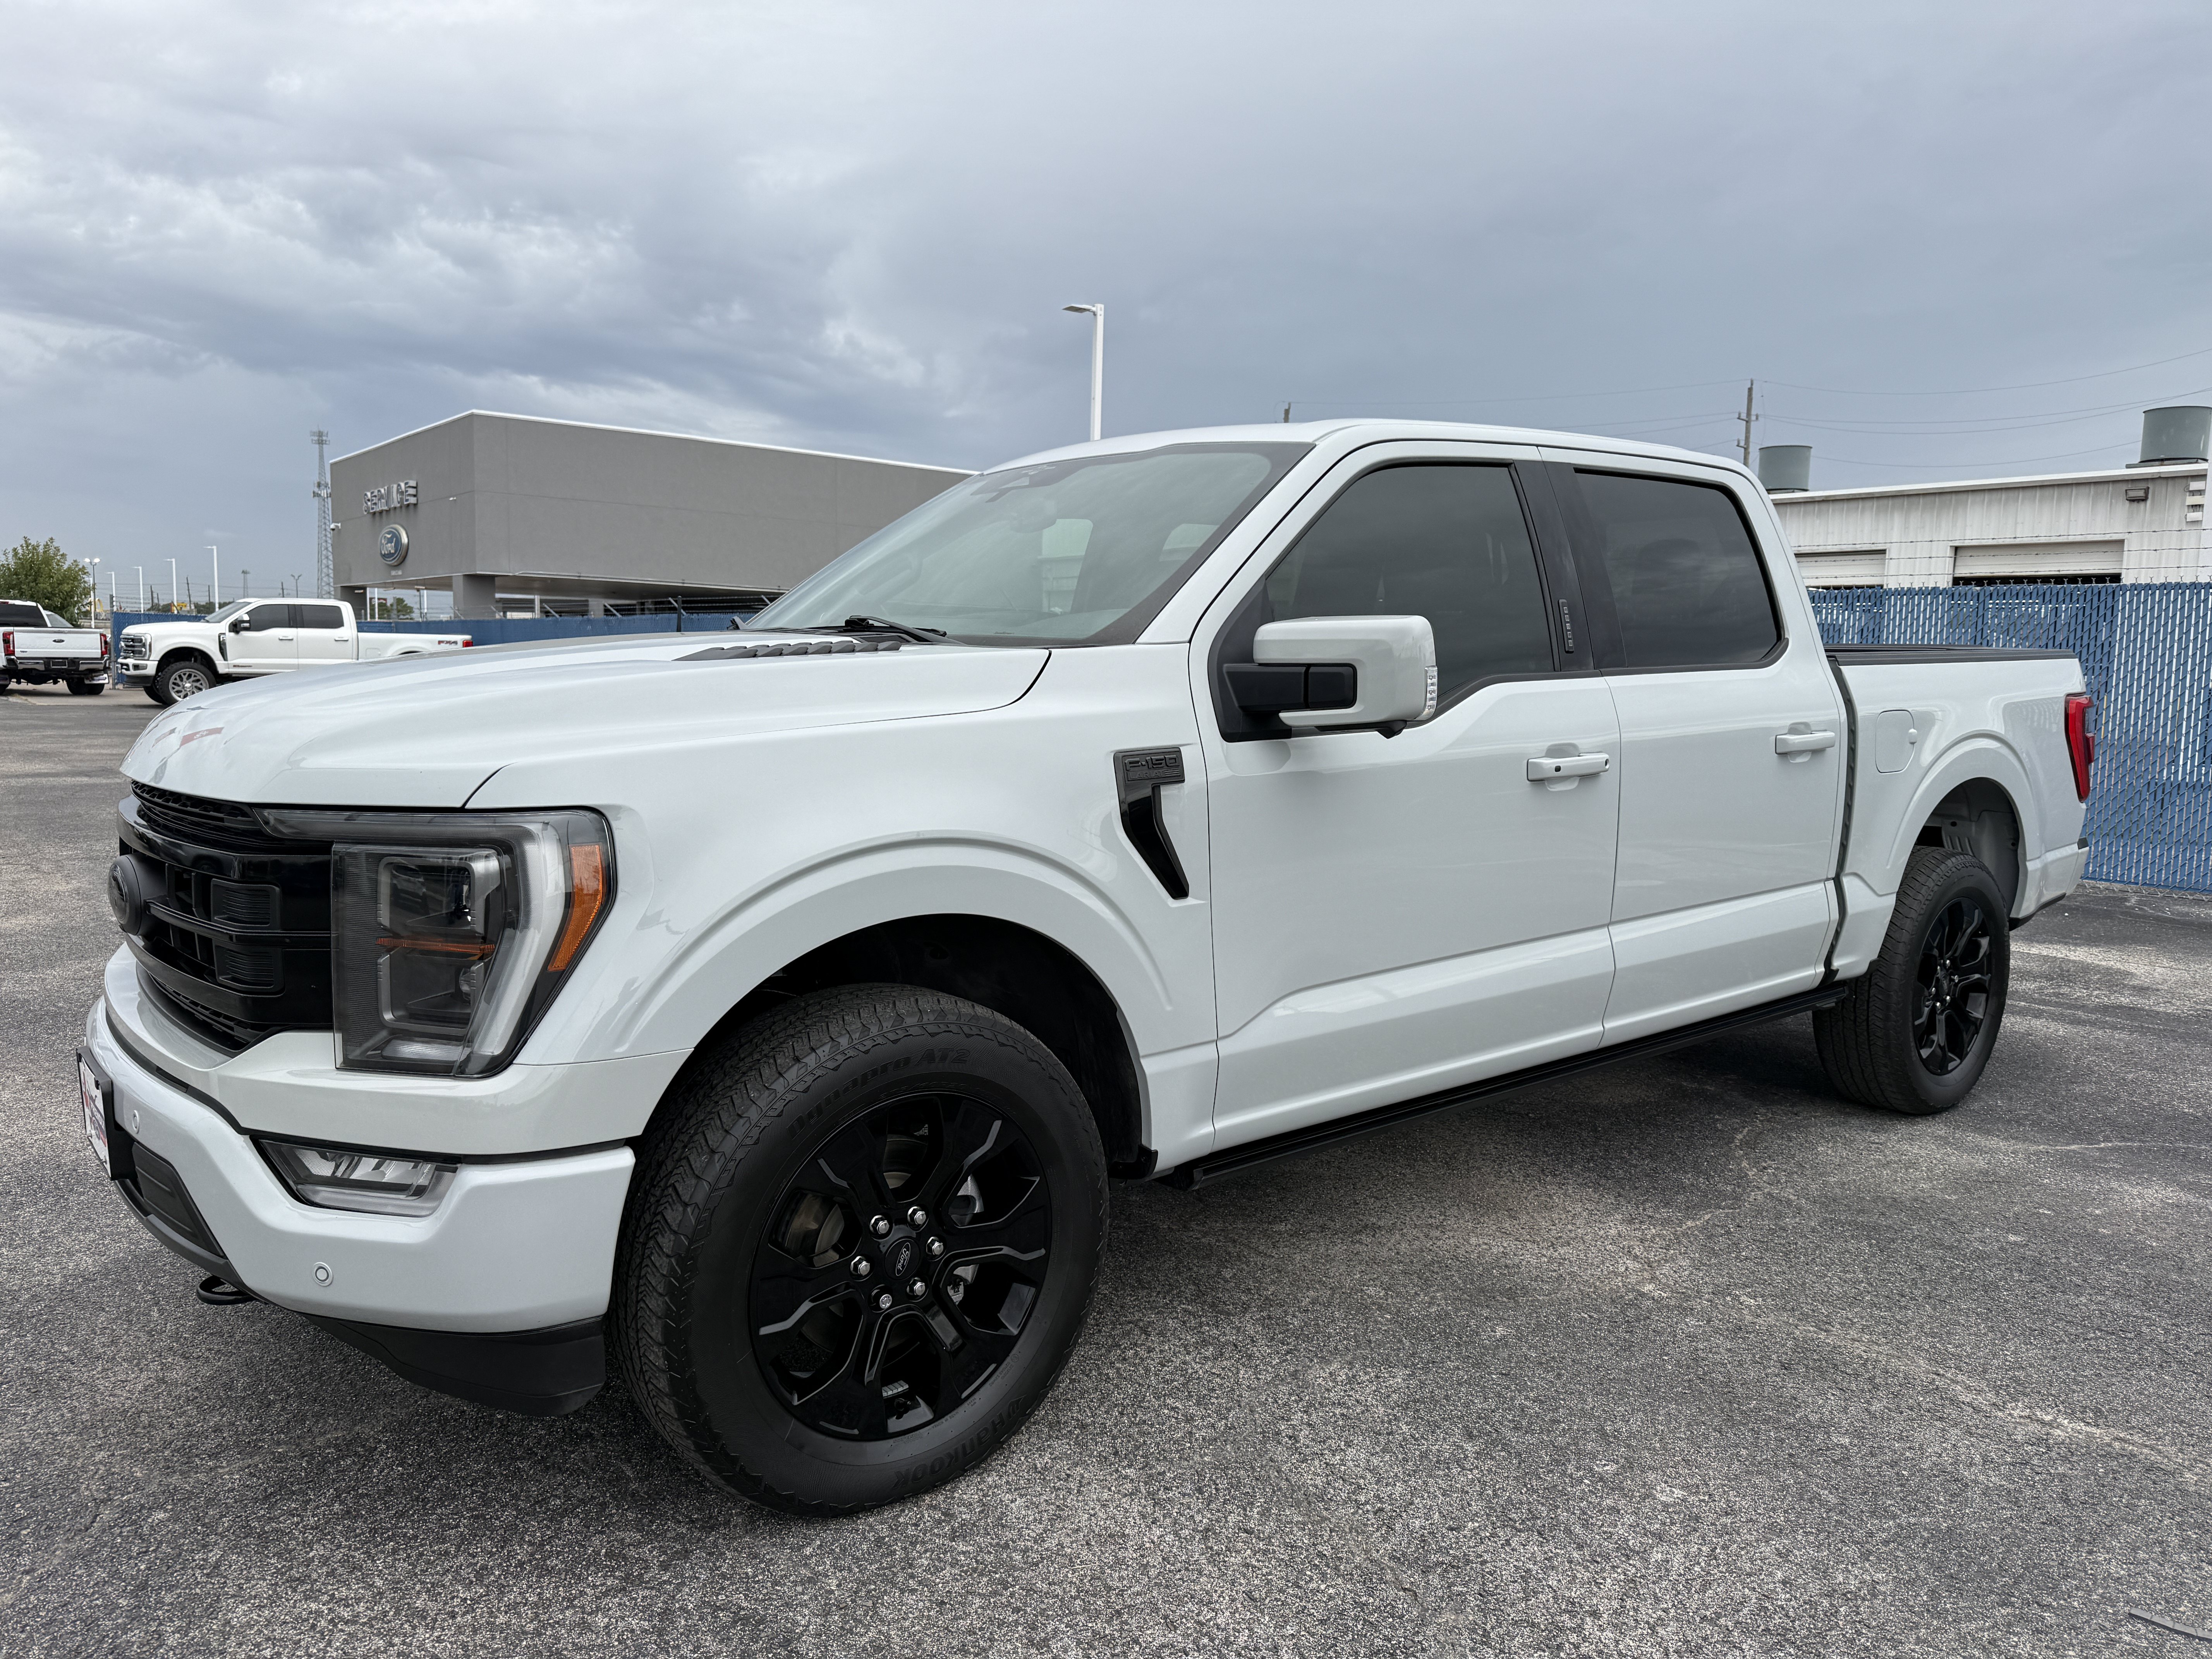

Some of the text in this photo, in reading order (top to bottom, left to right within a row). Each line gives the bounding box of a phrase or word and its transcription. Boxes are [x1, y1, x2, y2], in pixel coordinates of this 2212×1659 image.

[363, 480, 417, 514] SERVICE
[381, 534, 395, 554] Ford
[1125, 755, 1180, 770] F-150
[1128, 771, 1164, 780] LARIAT
[787, 1048, 970, 1140] Dynapro AT2
[897, 1248, 909, 1270] Ford
